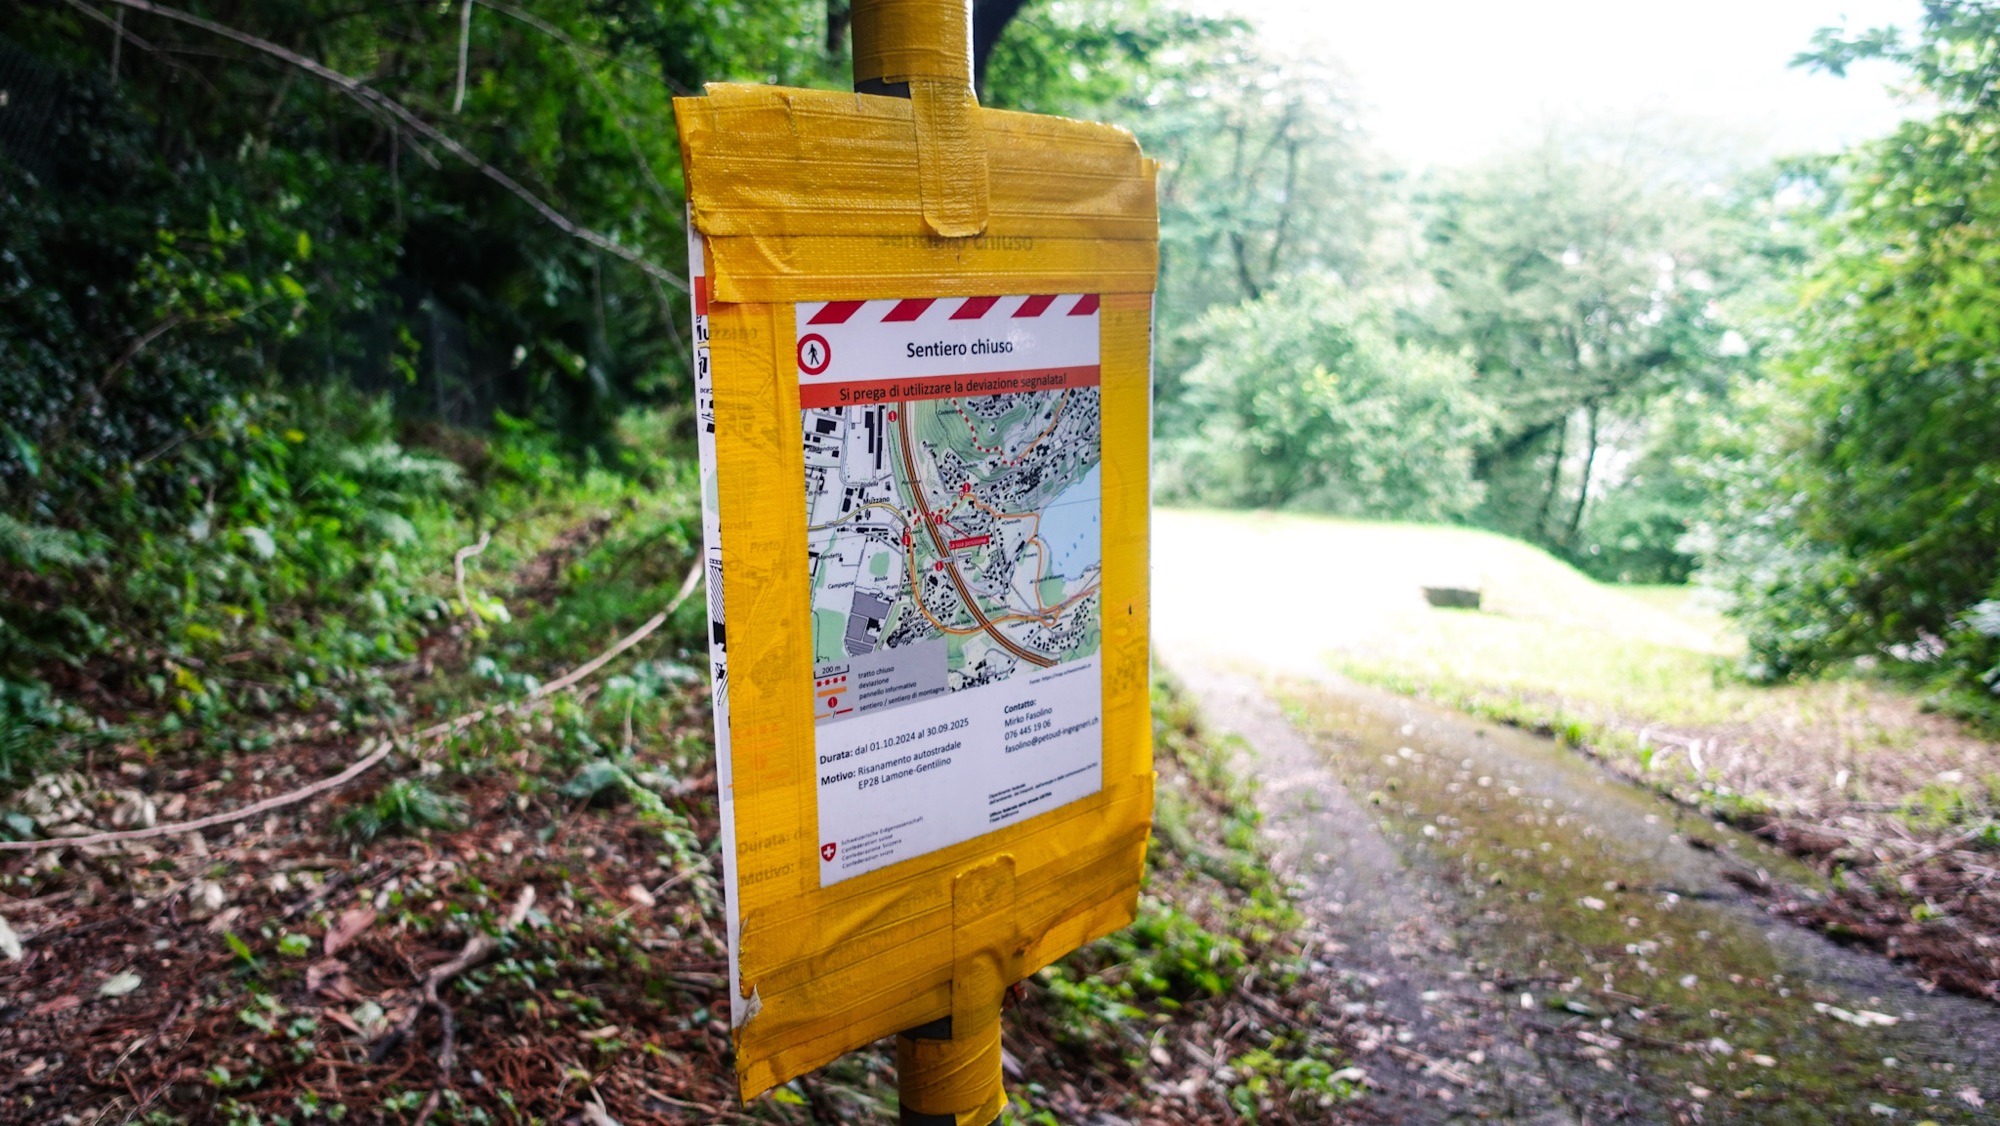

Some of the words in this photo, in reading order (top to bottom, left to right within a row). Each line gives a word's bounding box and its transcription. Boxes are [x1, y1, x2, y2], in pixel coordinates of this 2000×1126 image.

[907, 340, 967, 358] Sentiero
[971, 338, 1013, 355] chiuso
[840, 387, 850, 401] Si
[853, 385, 887, 404] prega
[890, 385, 900, 398] di
[903, 381, 951, 397] utilizzare
[954, 379, 964, 394] la
[966, 375, 1018, 393] deviazione
[1020, 371, 1067, 391] segnalata!
[822, 665, 834, 675] 200
[858, 668, 876, 679] tratto
[876, 665, 895, 676] chiuso
[858, 677, 890, 690] deviazione
[859, 687, 884, 701] pannello
[885, 681, 917, 694] informativo
[859, 700, 884, 712] sentiero
[888, 693, 911, 706] sentiero
[918, 686, 945, 700] montagna
[1004, 699, 1037, 714] Contatto:
[1004, 715, 1025, 727] Mirko
[1026, 707, 1053, 721] Fasolino
[819, 749, 854, 765] Durata:
[854, 744, 868, 756] dal
[869, 732, 916, 752] 01.10.2024
[917, 727, 925, 738] al
[927, 717, 970, 737] 30.09.2025
[1004, 729, 1018, 741] 076
[1019, 726, 1032, 736] 445
[1033, 722, 1042, 732] 19
[1042, 719, 1052, 729] 06
[1004, 716, 1100, 754] fasolino@petoud-ingegneri.ch
[820, 770, 857, 786] Motivo:
[857, 755, 912, 777] Risanamento
[913, 740, 962, 762] autostradale
[858, 775, 880, 790] EP28
[881, 757, 952, 784] Lamone-Gentilino
[841, 830, 879, 846] Schweizerische
[880, 816, 924, 834] Eidgenossenschaft
[738, 832, 791, 855] Durata:
[842, 845, 881, 861] Confederazione
[882, 838, 902, 849] Svizzera
[842, 853, 879, 869] Confederaziun
[739, 862, 796, 888] Motivo:
